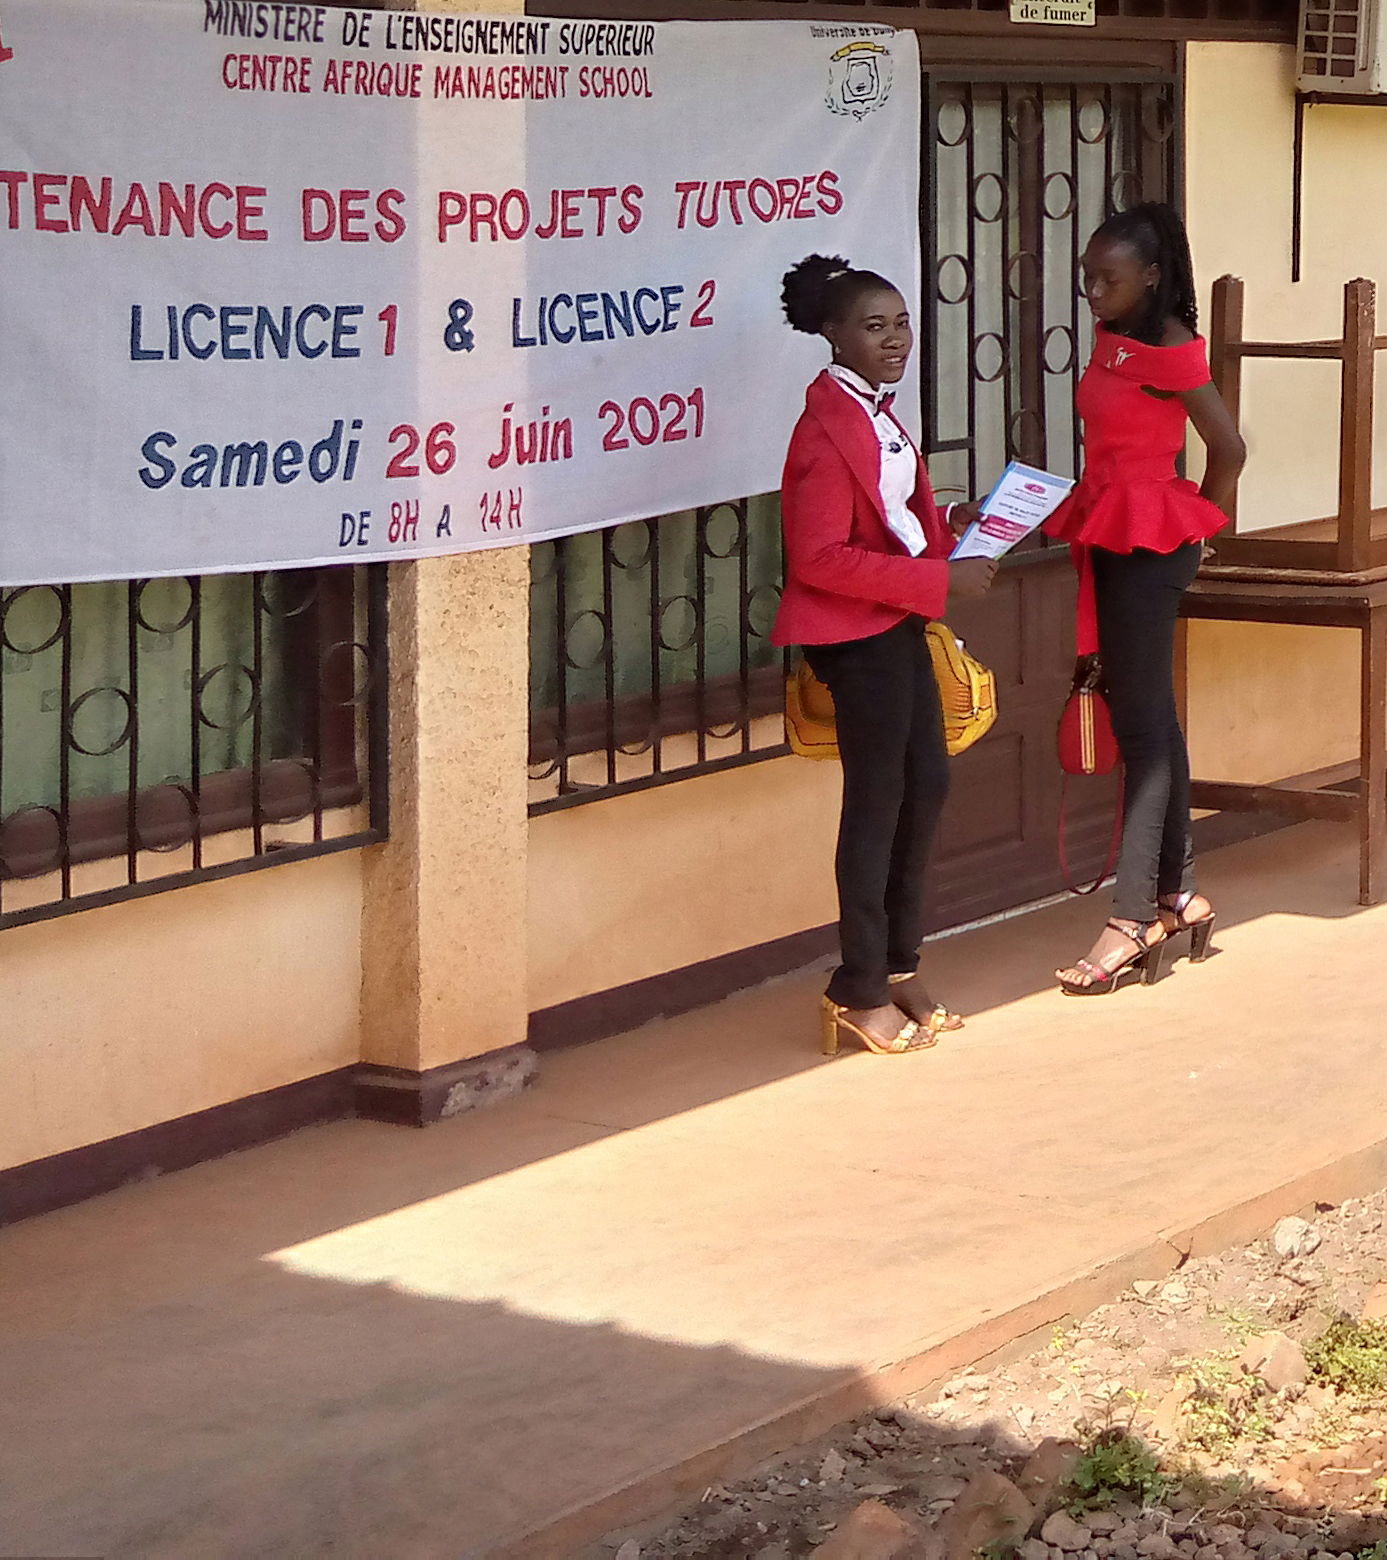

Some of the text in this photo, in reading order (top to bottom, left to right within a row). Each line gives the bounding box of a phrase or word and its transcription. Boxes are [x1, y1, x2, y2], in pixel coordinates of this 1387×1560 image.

[204, 0, 655, 56] MINISTERE DE L'ENSEIGNEMENT SUPERIEUR
[1020, 5, 1086, 21] de fumer
[222, 53, 653, 100] CENTRE AFRIQUE MANAGEMENT SCHOOL
[302, 188, 407, 242] DES
[438, 184, 644, 243] PROJETS
[675, 170, 843, 229] TUTORES
[130, 303, 364, 360] LICENCE
[443, 298, 476, 352] &
[512, 284, 684, 348] LICENCE
[138, 418, 363, 489] Samedi
[385, 421, 456, 478] 26
[598, 387, 704, 452] 2021
[339, 511, 371, 547] DE
[388, 499, 419, 543] 8H
[436, 504, 452, 537] A
